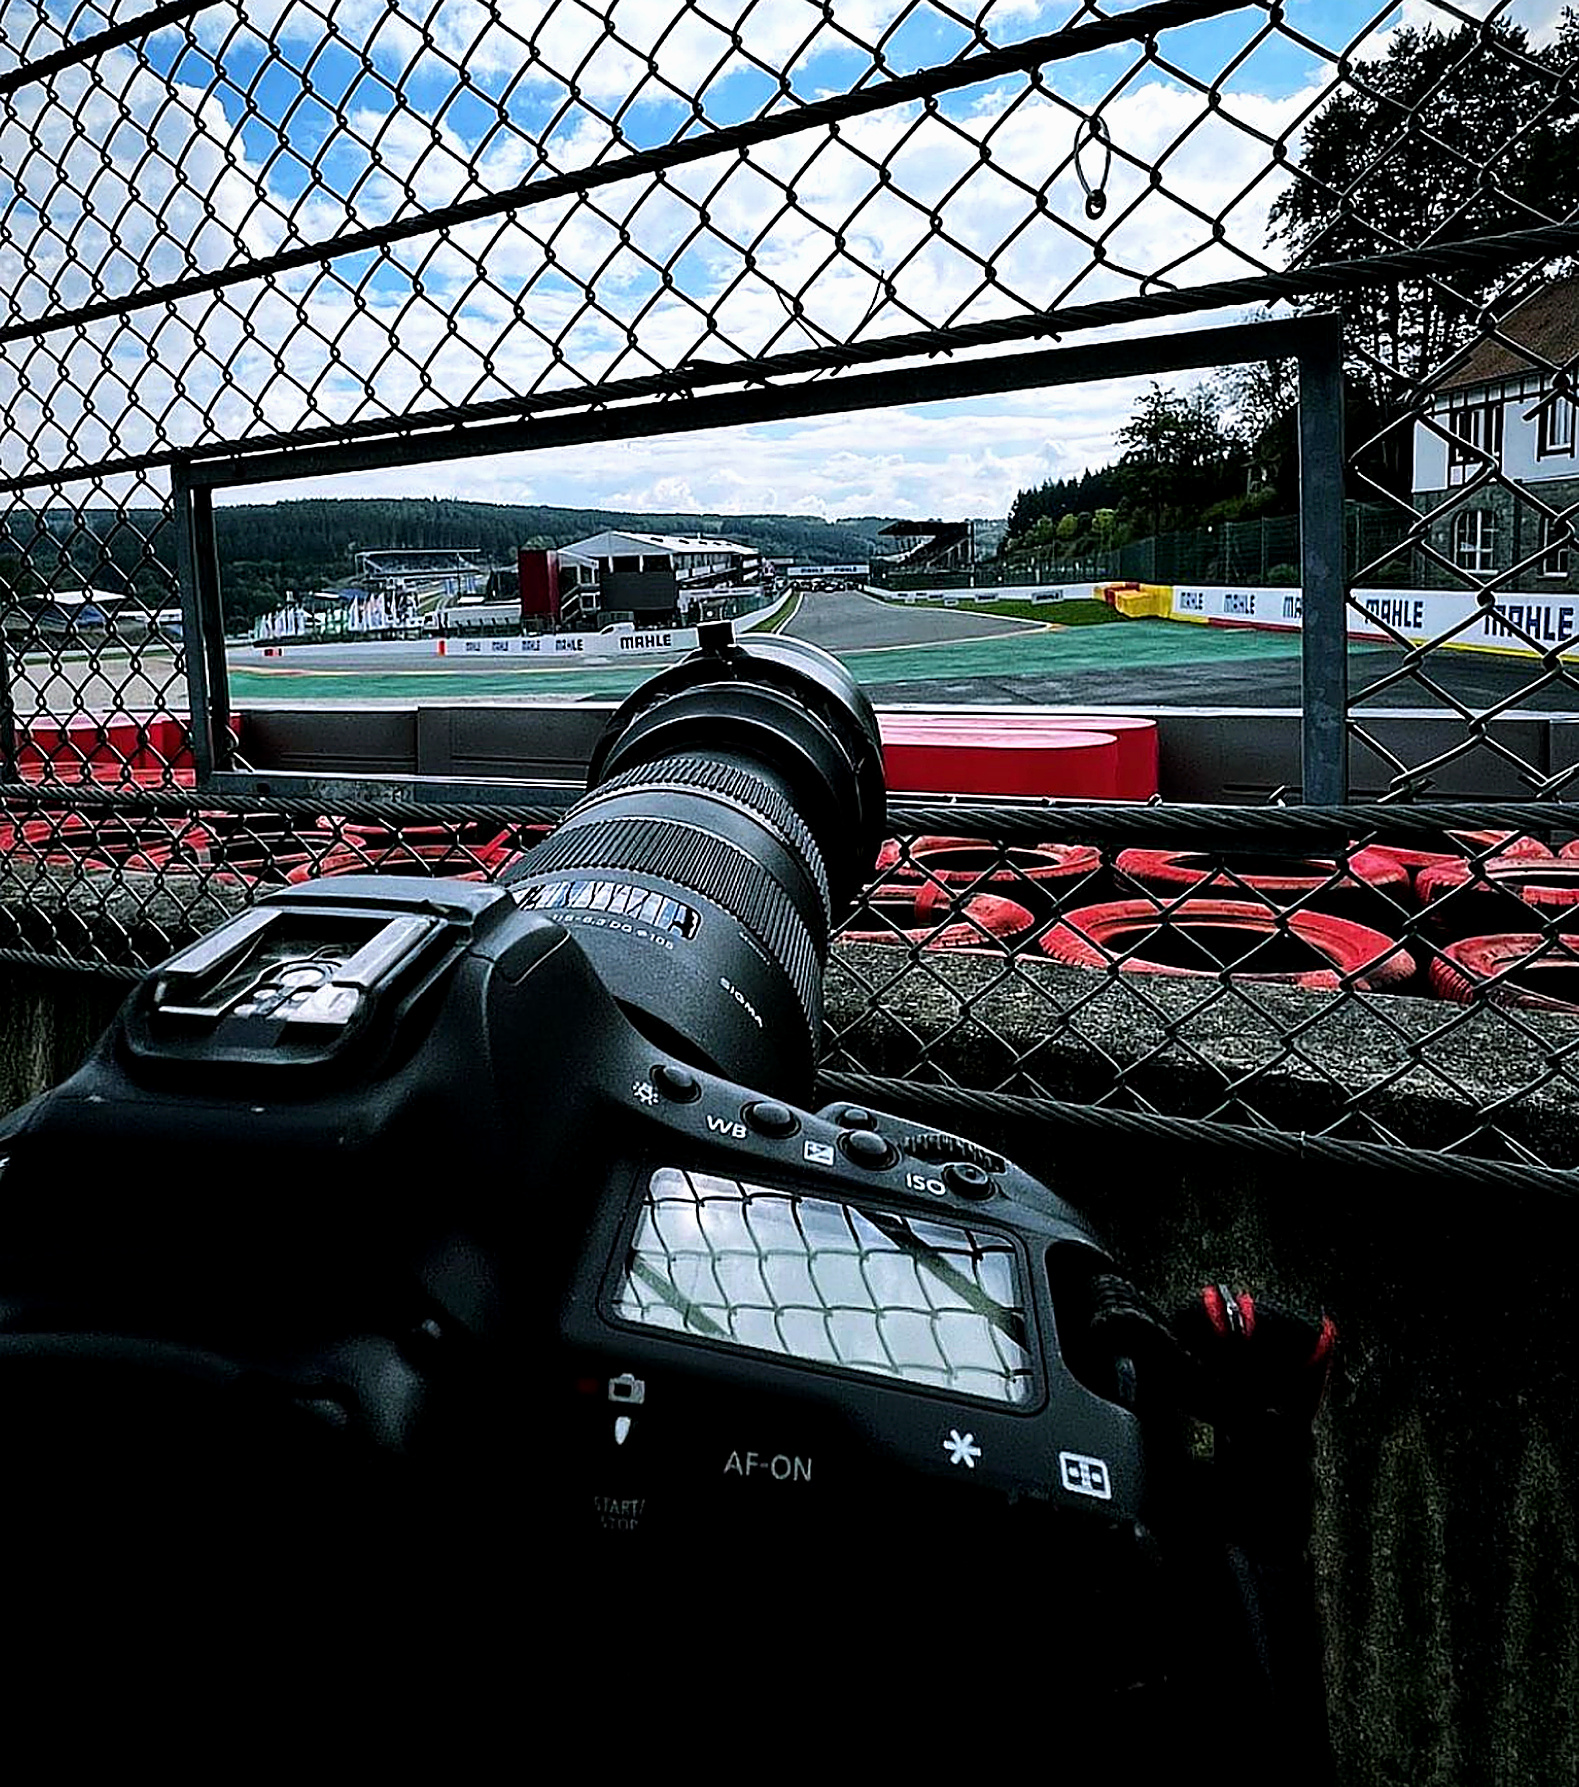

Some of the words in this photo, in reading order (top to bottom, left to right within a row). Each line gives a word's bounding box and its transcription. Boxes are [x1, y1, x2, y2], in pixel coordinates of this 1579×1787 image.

[1366, 599, 1424, 628] MAHLE
[1484, 604, 1574, 641] MAHLE
[620, 634, 671, 650] MAHLE
[720, 977, 763, 1028] SIGMA
[706, 1114, 747, 1139] WB
[906, 1172, 946, 1196] ISO
[723, 1450, 812, 1482] AF-ON
